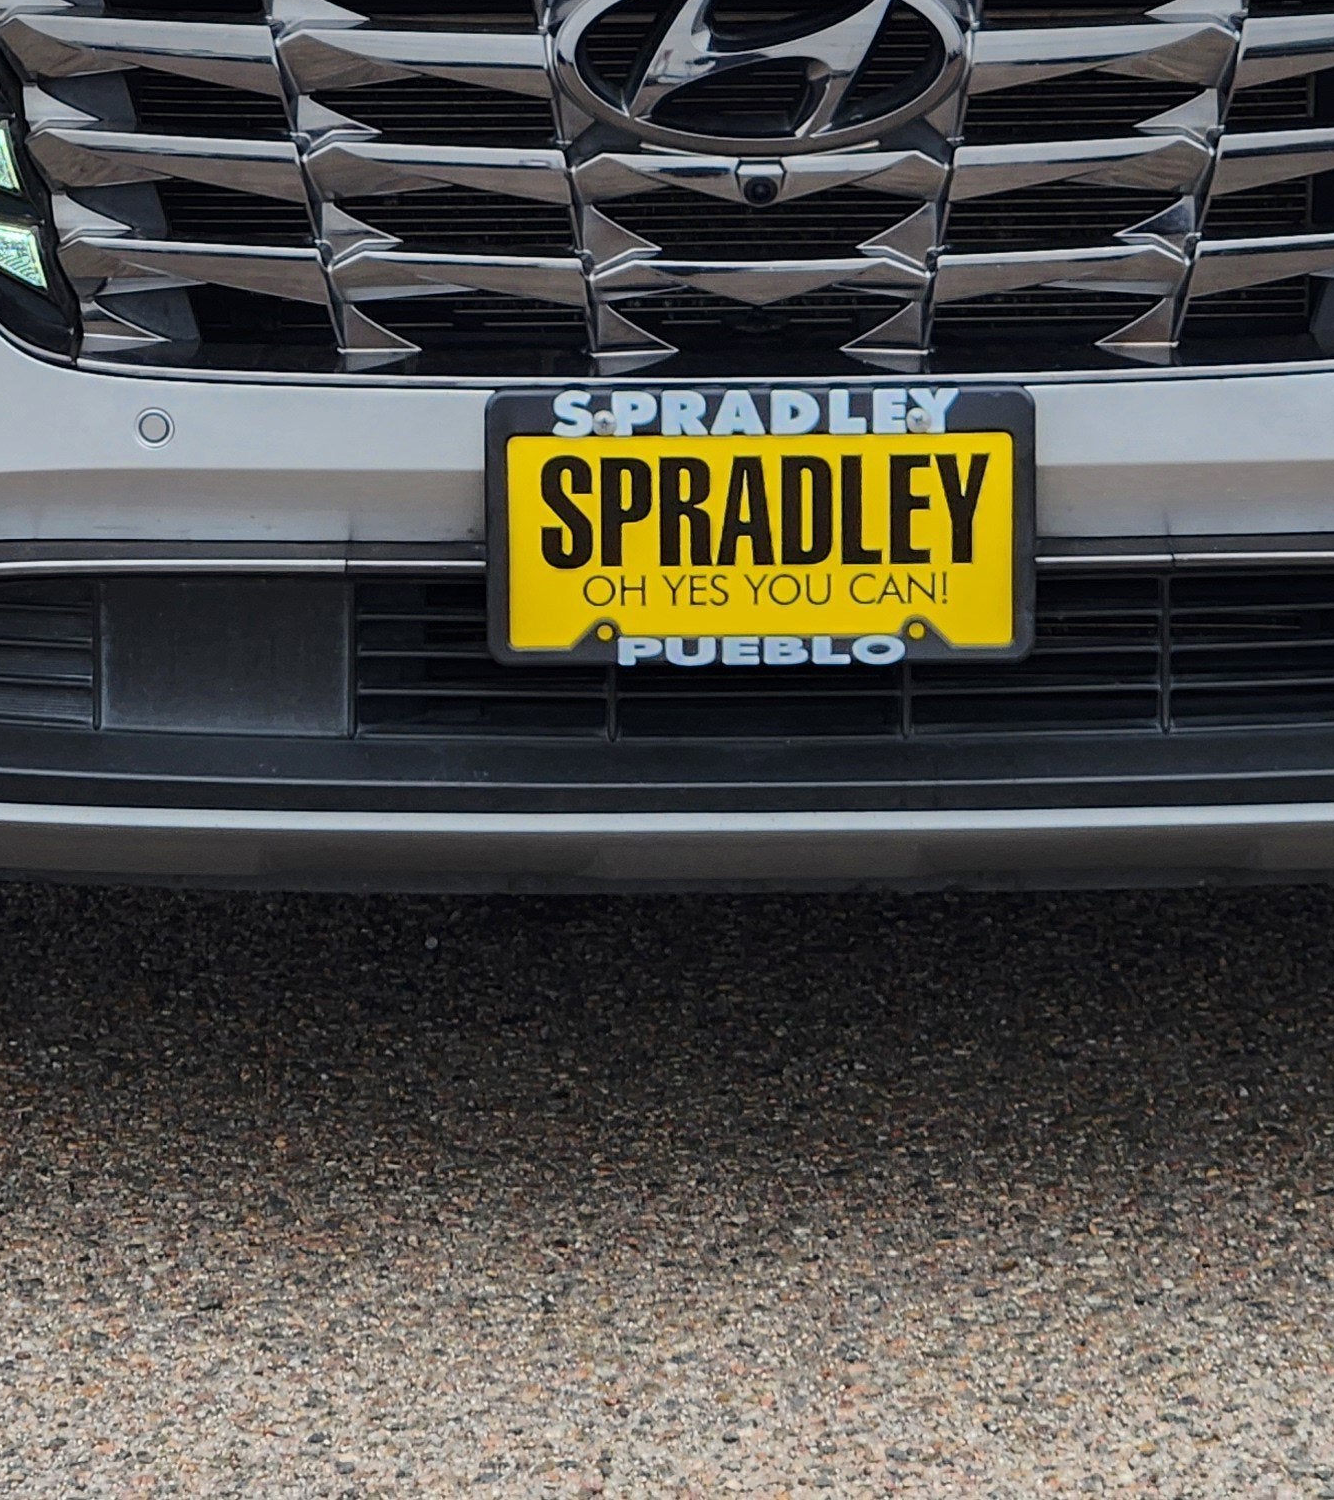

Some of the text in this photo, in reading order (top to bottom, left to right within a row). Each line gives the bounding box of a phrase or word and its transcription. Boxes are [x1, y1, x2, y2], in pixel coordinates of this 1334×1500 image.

[540, 453, 990, 570] SPRADLEY
[582, 572, 948, 607] OH YES YOU CAN!
[617, 634, 906, 666] PUEBLO
